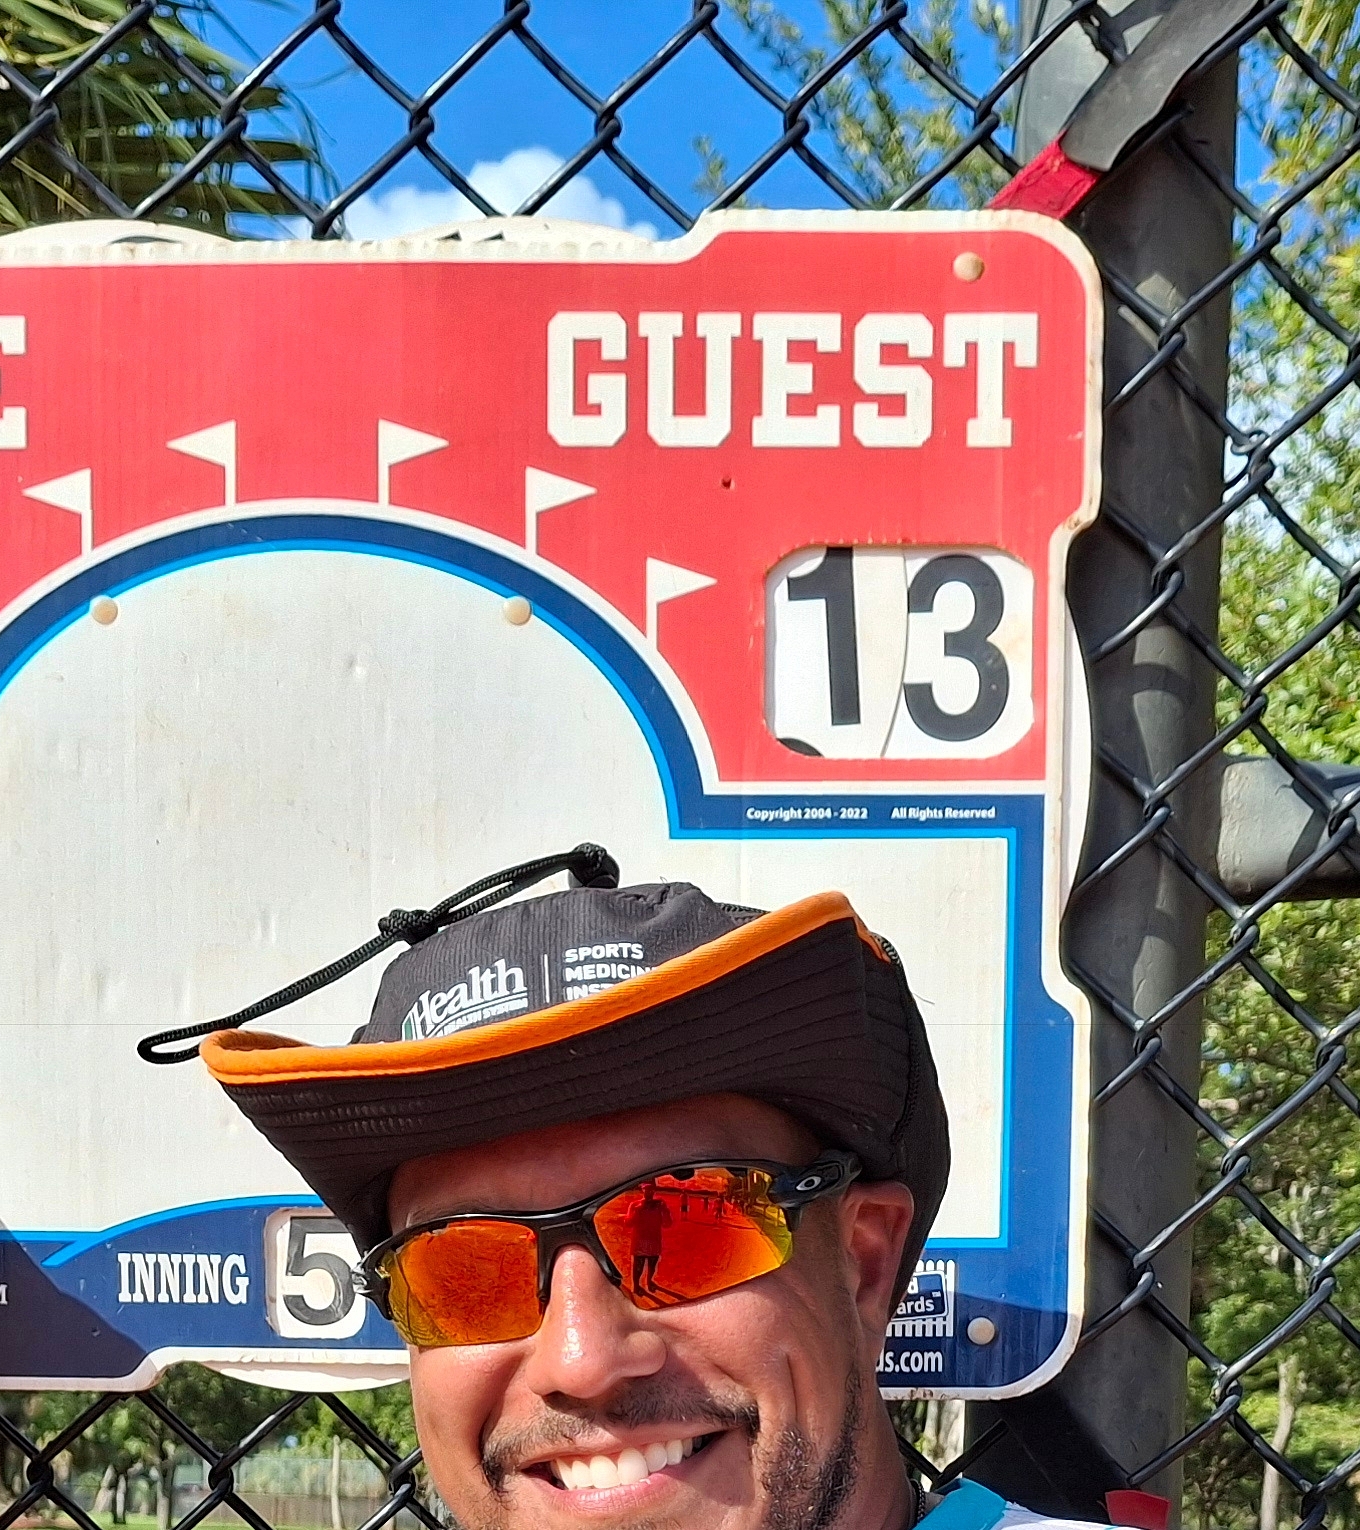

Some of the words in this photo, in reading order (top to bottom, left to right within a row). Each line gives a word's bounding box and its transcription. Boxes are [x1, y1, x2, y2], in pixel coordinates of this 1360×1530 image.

[546, 312, 1039, 448] GUEST
[786, 545, 1011, 743] 13
[746, 807, 802, 822] Copyright
[803, 807, 832, 819] 2004
[891, 807, 907, 819] All
[908, 807, 943, 821] Rights
[944, 806, 996, 819] Reserved
[564, 942, 644, 963] SPORTS
[402, 958, 528, 1041] Health
[117, 1253, 249, 1304] INNING
[283, 1216, 356, 1326] 5
